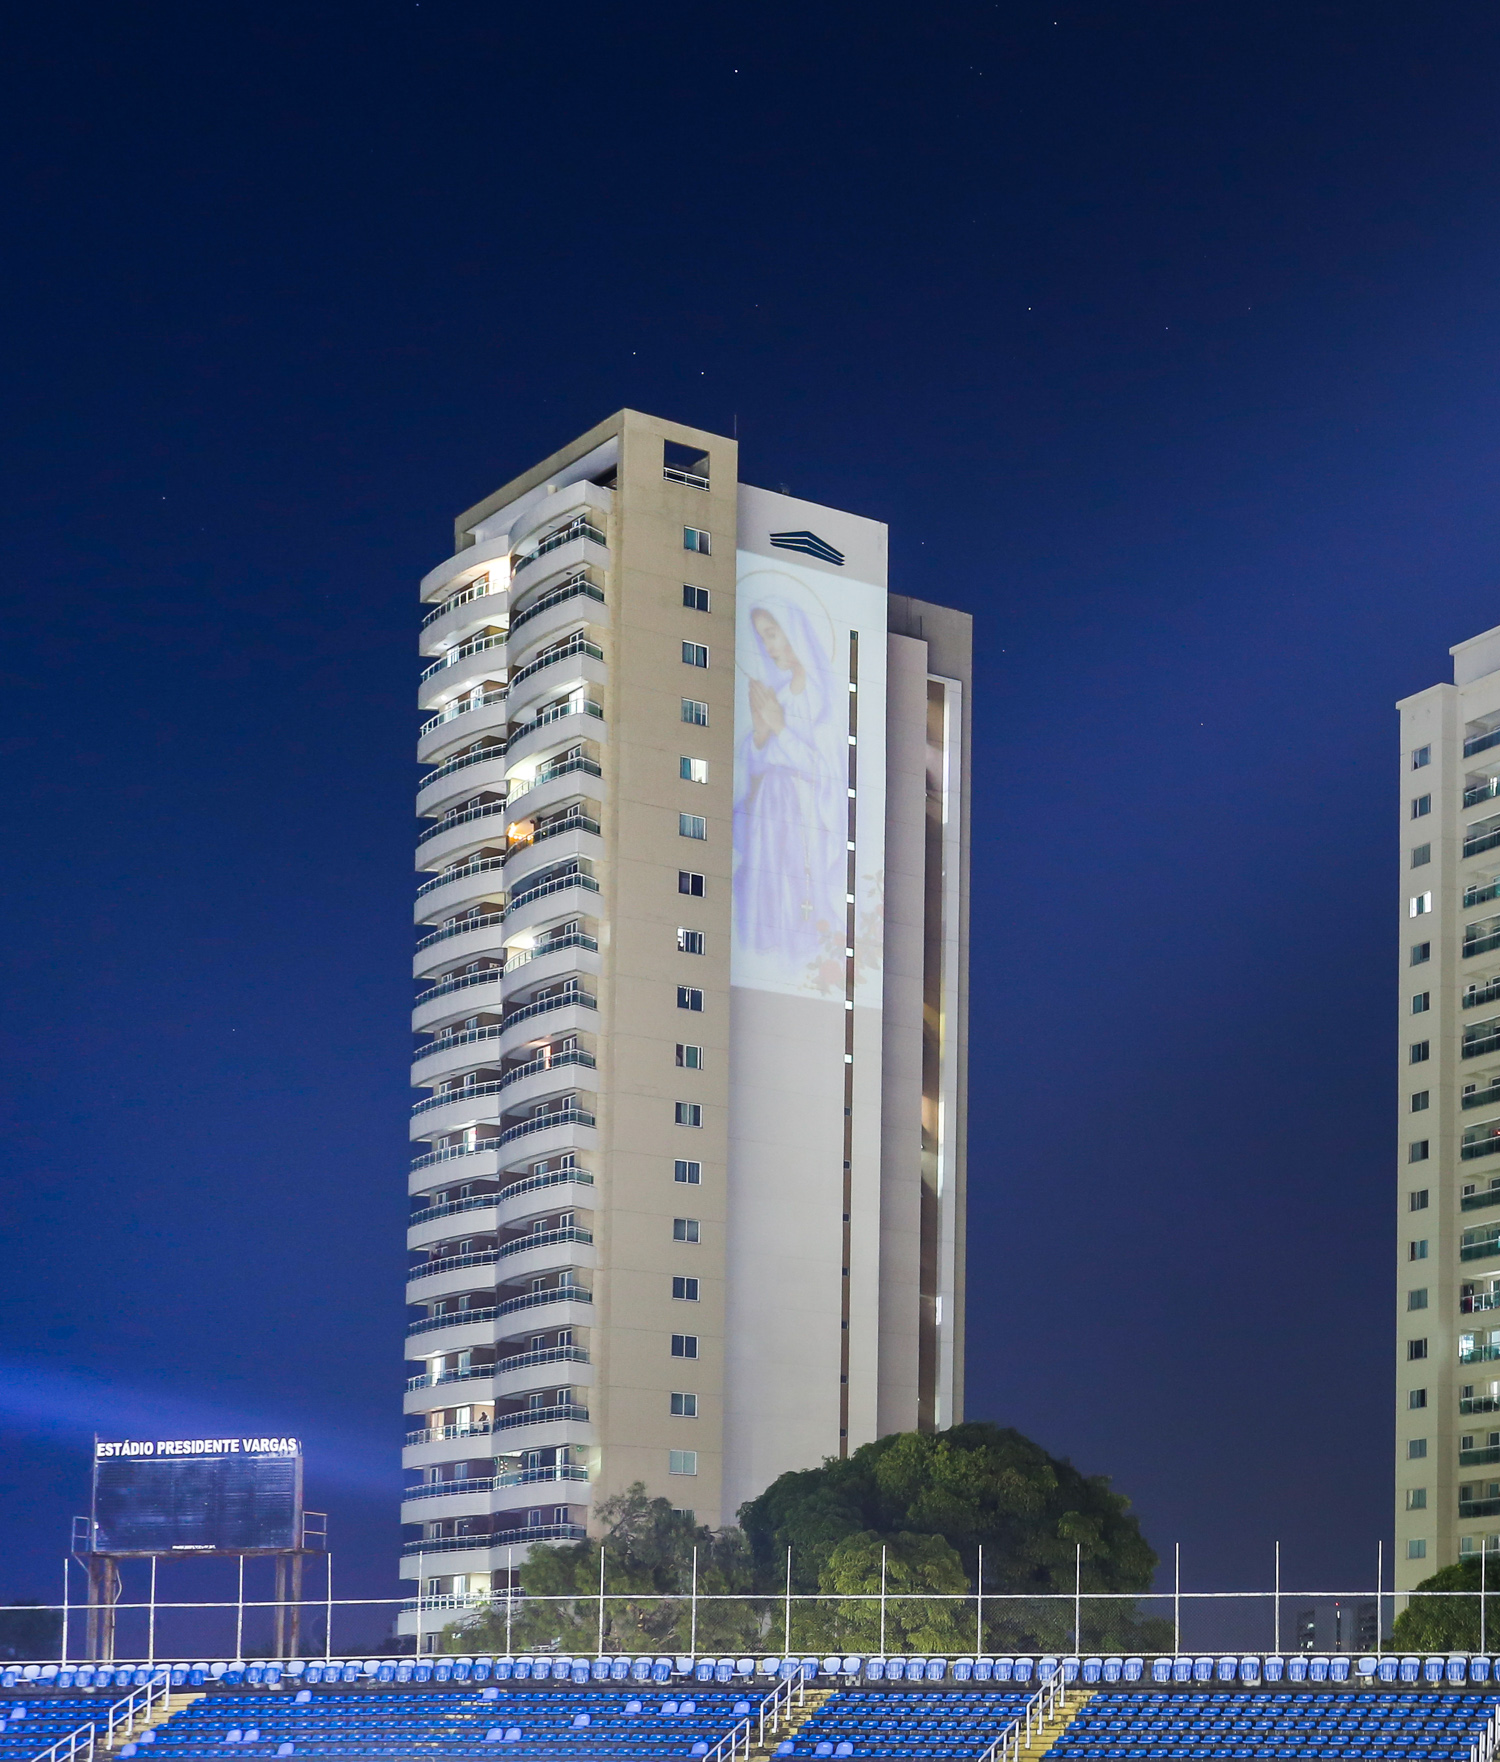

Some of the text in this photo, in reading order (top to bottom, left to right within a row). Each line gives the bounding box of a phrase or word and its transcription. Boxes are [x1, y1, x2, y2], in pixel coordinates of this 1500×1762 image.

[96, 1438, 297, 1457] ESTÁDIO PRESIDENTE VARGAS
